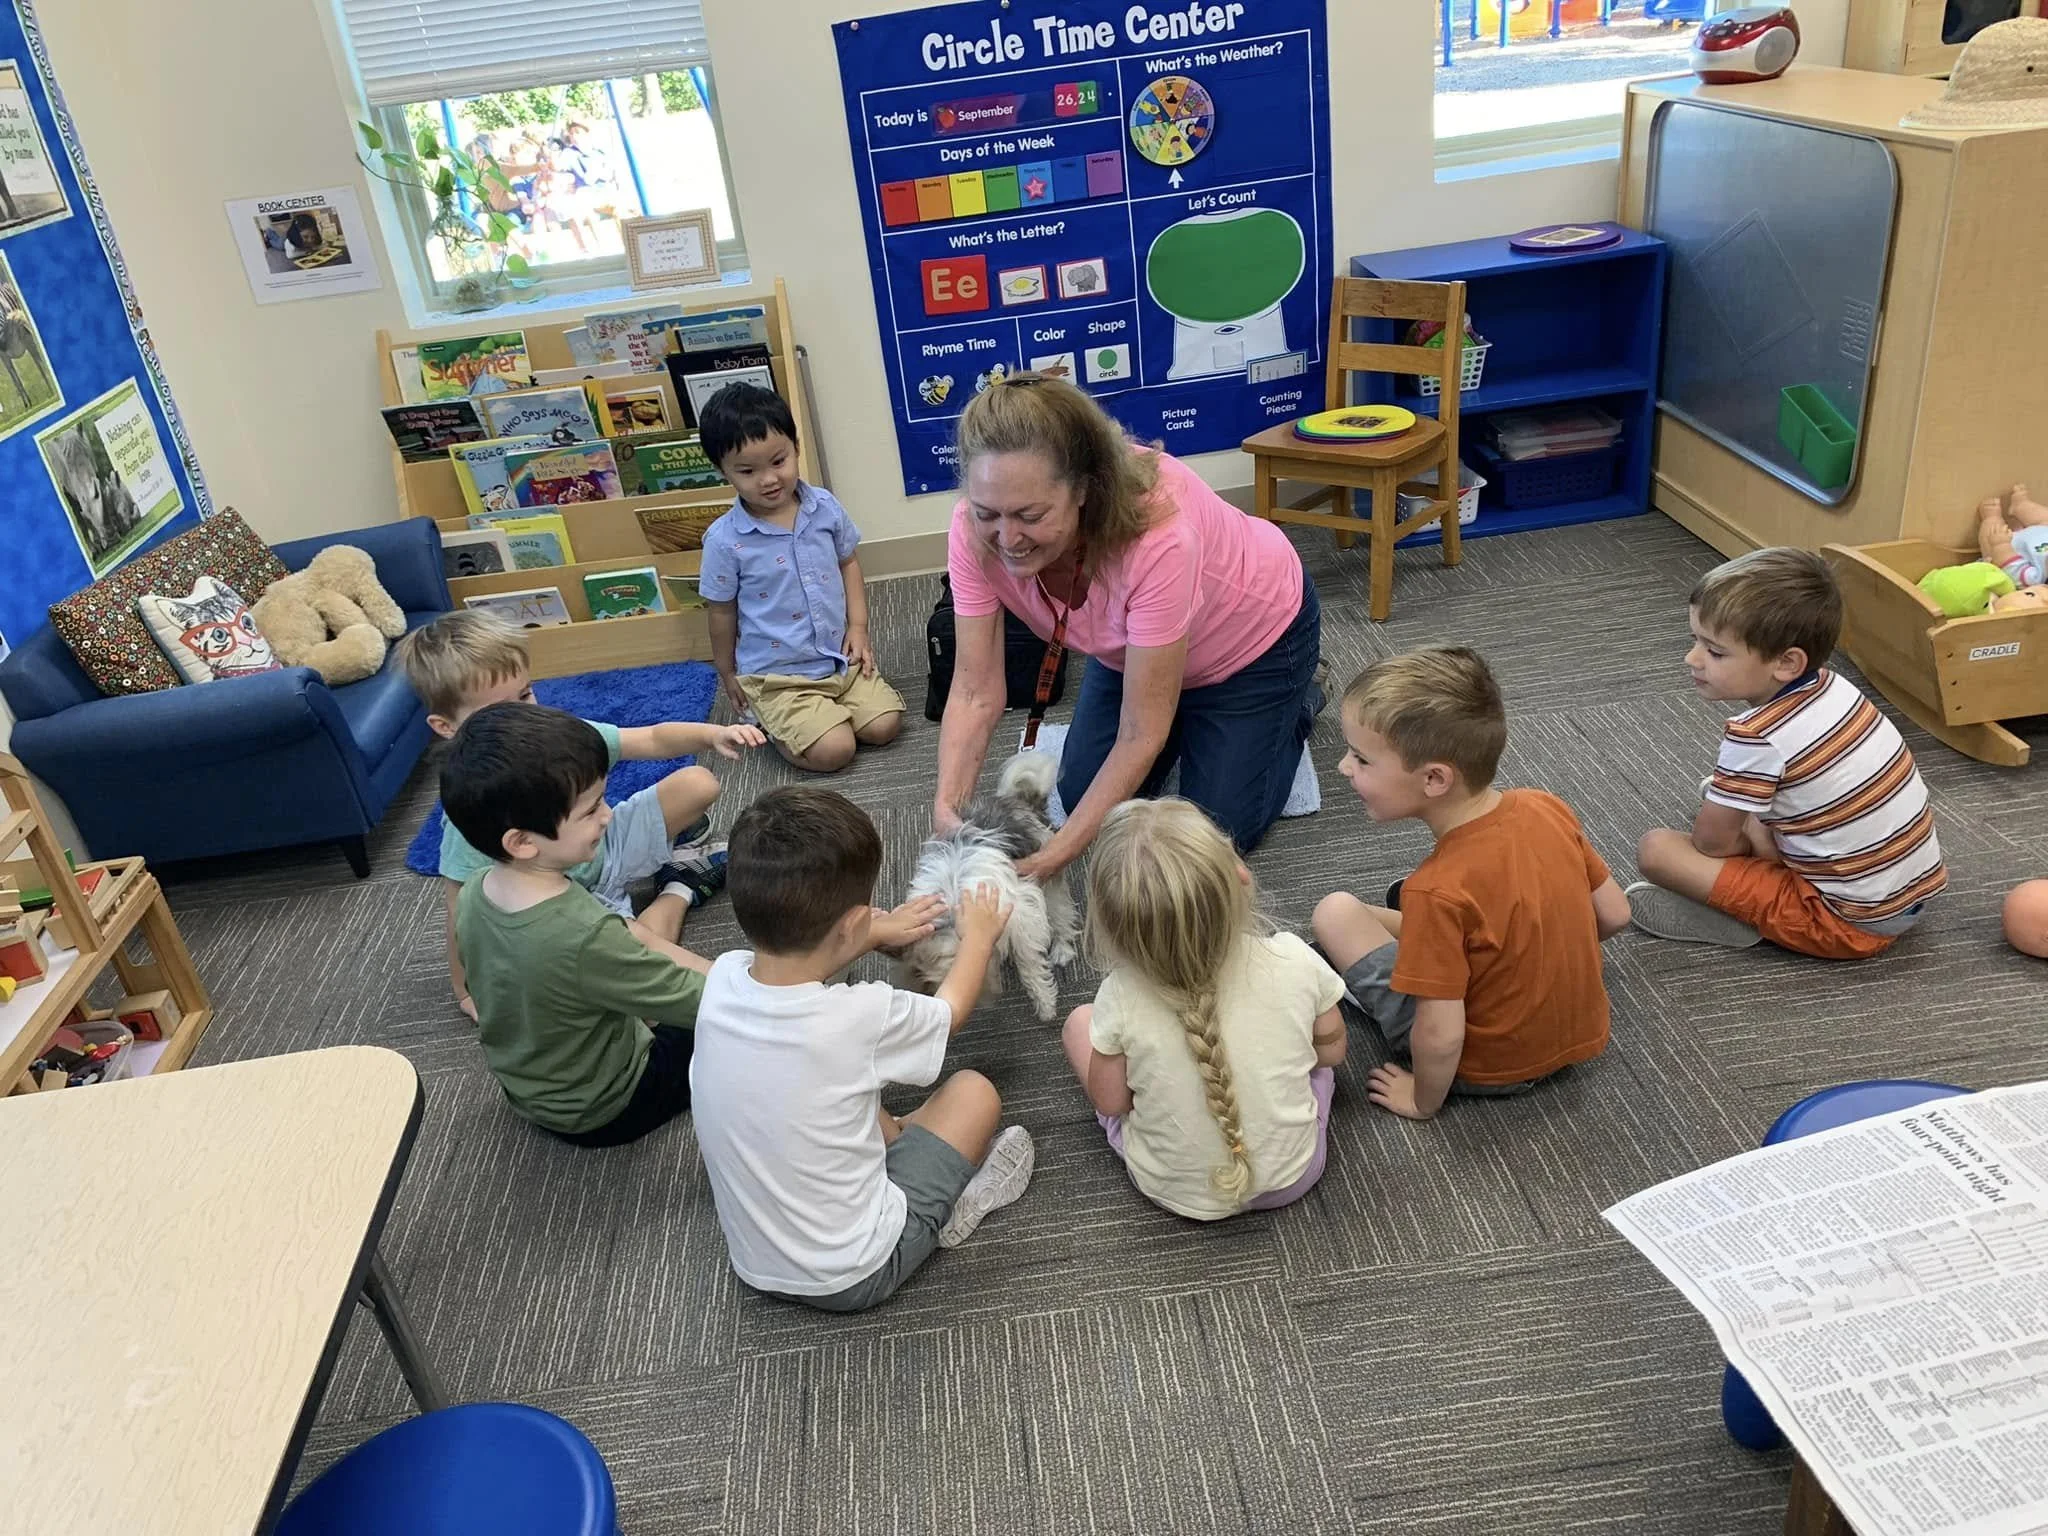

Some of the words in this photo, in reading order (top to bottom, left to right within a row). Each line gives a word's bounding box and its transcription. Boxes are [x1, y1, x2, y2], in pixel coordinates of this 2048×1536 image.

[922, 19, 1025, 71] Circle
[1033, 16, 1116, 57] Time
[1125, 1, 1245, 44] Center
[1145, 55, 1192, 73] What's
[1195, 53, 1217, 66] the
[1220, 41, 1284, 63] Weather?
[874, 112, 914, 128] Today
[917, 109, 929, 122] is
[958, 103, 1014, 121] September
[940, 147, 973, 162] Days
[976, 143, 990, 157] of
[993, 140, 1016, 154] the
[1017, 134, 1055, 151] Week
[71, 145, 88, 174] the
[86, 176, 104, 219] Bible
[99, 222, 119, 259] tells
[258, 201, 285, 213] BOOK
[286, 195, 326, 208] CENTER
[1188, 195, 1216, 210] Let's
[1219, 188, 1257, 205] Count
[949, 231, 993, 249] What's
[996, 227, 1018, 242] the
[1020, 222, 1065, 239] Letter?
[930, 268, 979, 302] Ee
[1034, 328, 1066, 342] Color
[1088, 319, 1127, 334] Shape
[922, 343, 964, 357] Rhyme
[966, 338, 997, 351] Time
[714, 359, 741, 370] Baby
[742, 355, 768, 367] Farm
[1099, 369, 1119, 378] circle
[1259, 390, 1302, 405] Counting
[1162, 408, 1197, 420] Picture
[1266, 403, 1297, 416] Pieces
[139, 337, 164, 380] Jesus
[161, 381, 177, 425] loves
[174, 426, 190, 450] me
[187, 451, 201, 481] this
[199, 491, 214, 518] kno
[1166, 419, 1195, 431] Cards
[660, 446, 704, 461] COW
[650, 463, 664, 472] IN
[665, 459, 686, 469] THE
[643, 509, 698, 526] FARMER
[700, 504, 732, 515] DUC
[1972, 644, 2018, 658] CRADLE
[1922, 1111, 1986, 1163] Matthews
[1984, 1164, 2013, 1186] has
[1964, 1172, 2007, 1203] night
